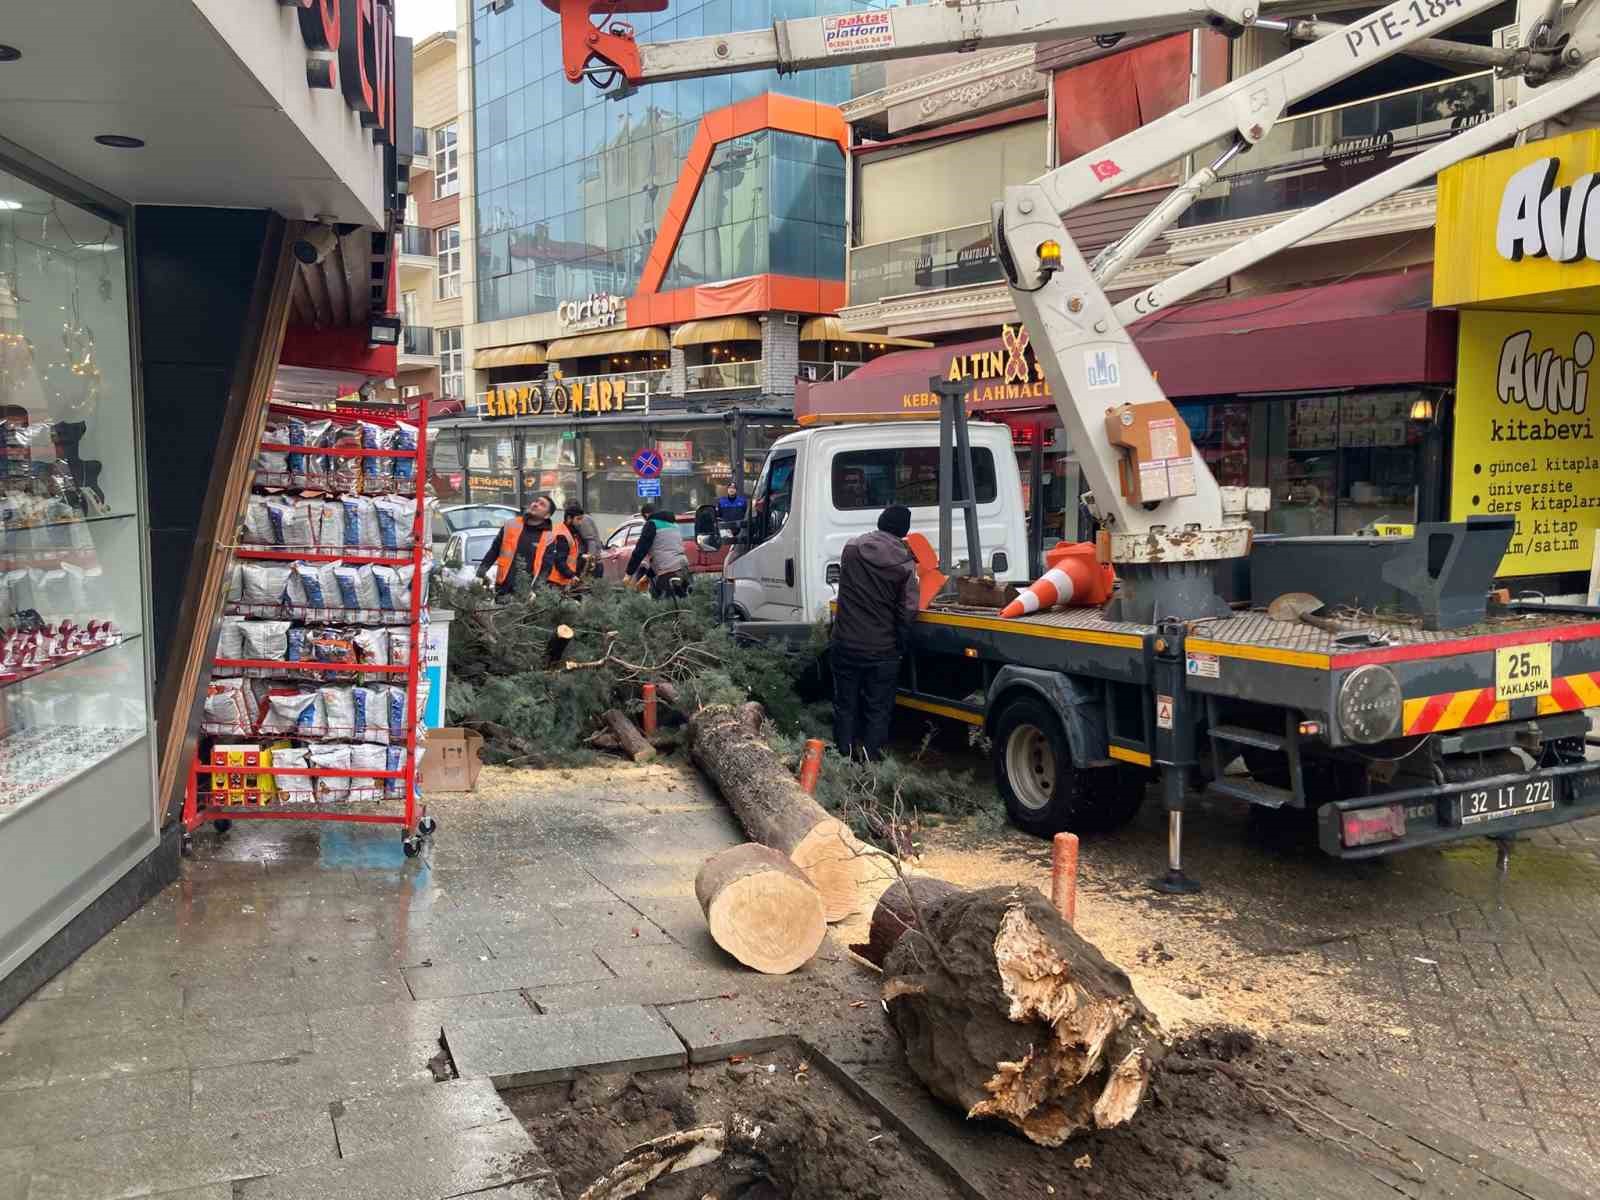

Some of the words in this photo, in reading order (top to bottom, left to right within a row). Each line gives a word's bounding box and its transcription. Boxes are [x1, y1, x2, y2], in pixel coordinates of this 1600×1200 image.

[826, 26, 889, 41] platform
[1330, 134, 1388, 155] ANATOLIA
[949, 350, 1004, 381] ALTIN
[589, 379, 626, 411] ART
[903, 392, 940, 408] KEBA
[1490, 418, 1594, 442] kitabevi
[1489, 458, 1537, 477] güncel
[1546, 456, 1600, 473] kitapla
[1488, 479, 1573, 496] üniversite
[1487, 498, 1522, 513] ders
[1533, 519, 1578, 536] kitap
[1504, 536, 1579, 555] ım/satım
[1471, 792, 1488, 814] 32
[1498, 787, 1515, 809] LT
[1526, 781, 1550, 804] 272
